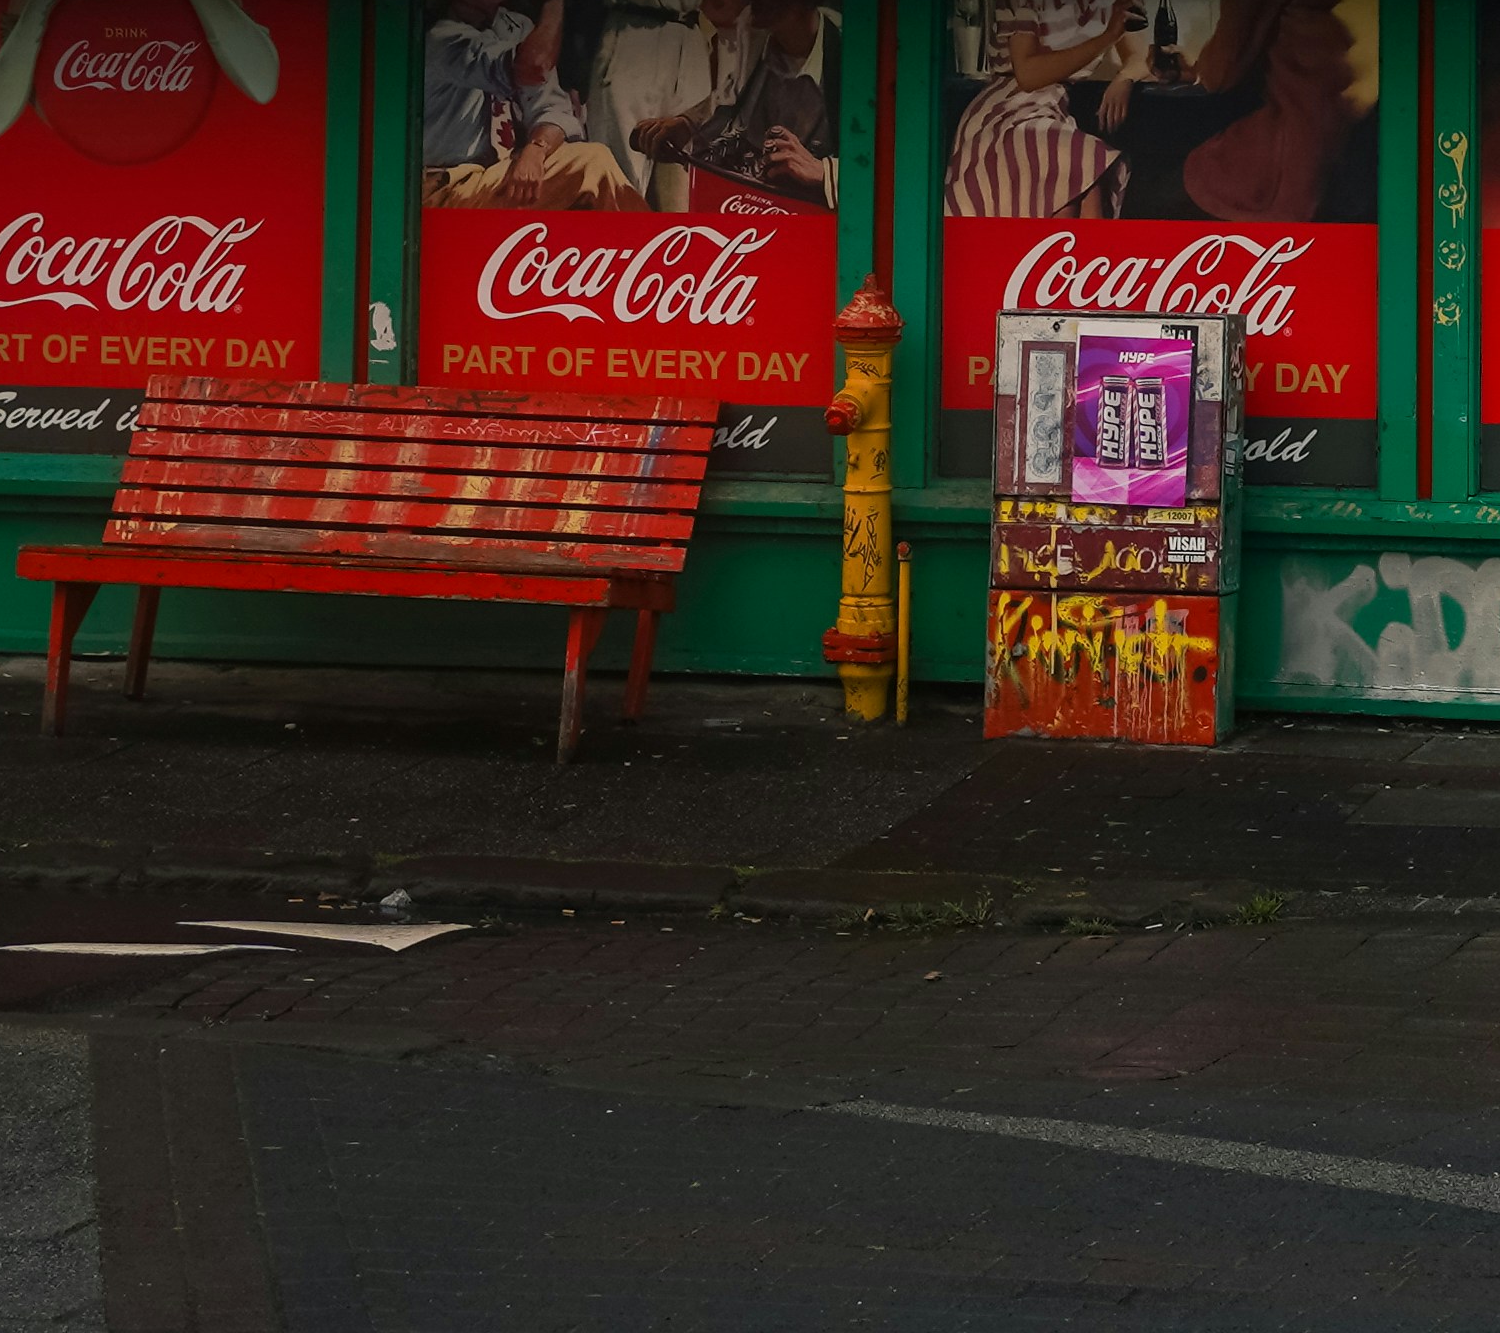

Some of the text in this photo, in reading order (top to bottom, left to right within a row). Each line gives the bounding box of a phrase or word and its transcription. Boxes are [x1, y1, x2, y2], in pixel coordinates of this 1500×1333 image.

[105, 27, 149, 38] DRINK
[53, 39, 201, 92] Coca-Cola
[745, 193, 773, 206] DRINK
[476, 222, 777, 325] Coca-Cola
[42, 334, 88, 363] OF
[100, 336, 215, 367] EVERY
[226, 339, 295, 369] DAY
[442, 344, 531, 374] PART
[546, 347, 594, 377] OF
[607, 348, 727, 381] EVERY
[737, 352, 810, 384] DAY
[1119, 351, 1155, 364] HYPE
[1275, 363, 1350, 395] DAY
[116, 399, 158, 431] ic
[712, 415, 770, 450] old
[1102, 390, 1120, 459] HYPE
[1139, 393, 1158, 460] HYPE
[1168, 536, 1206, 551] VISAH
